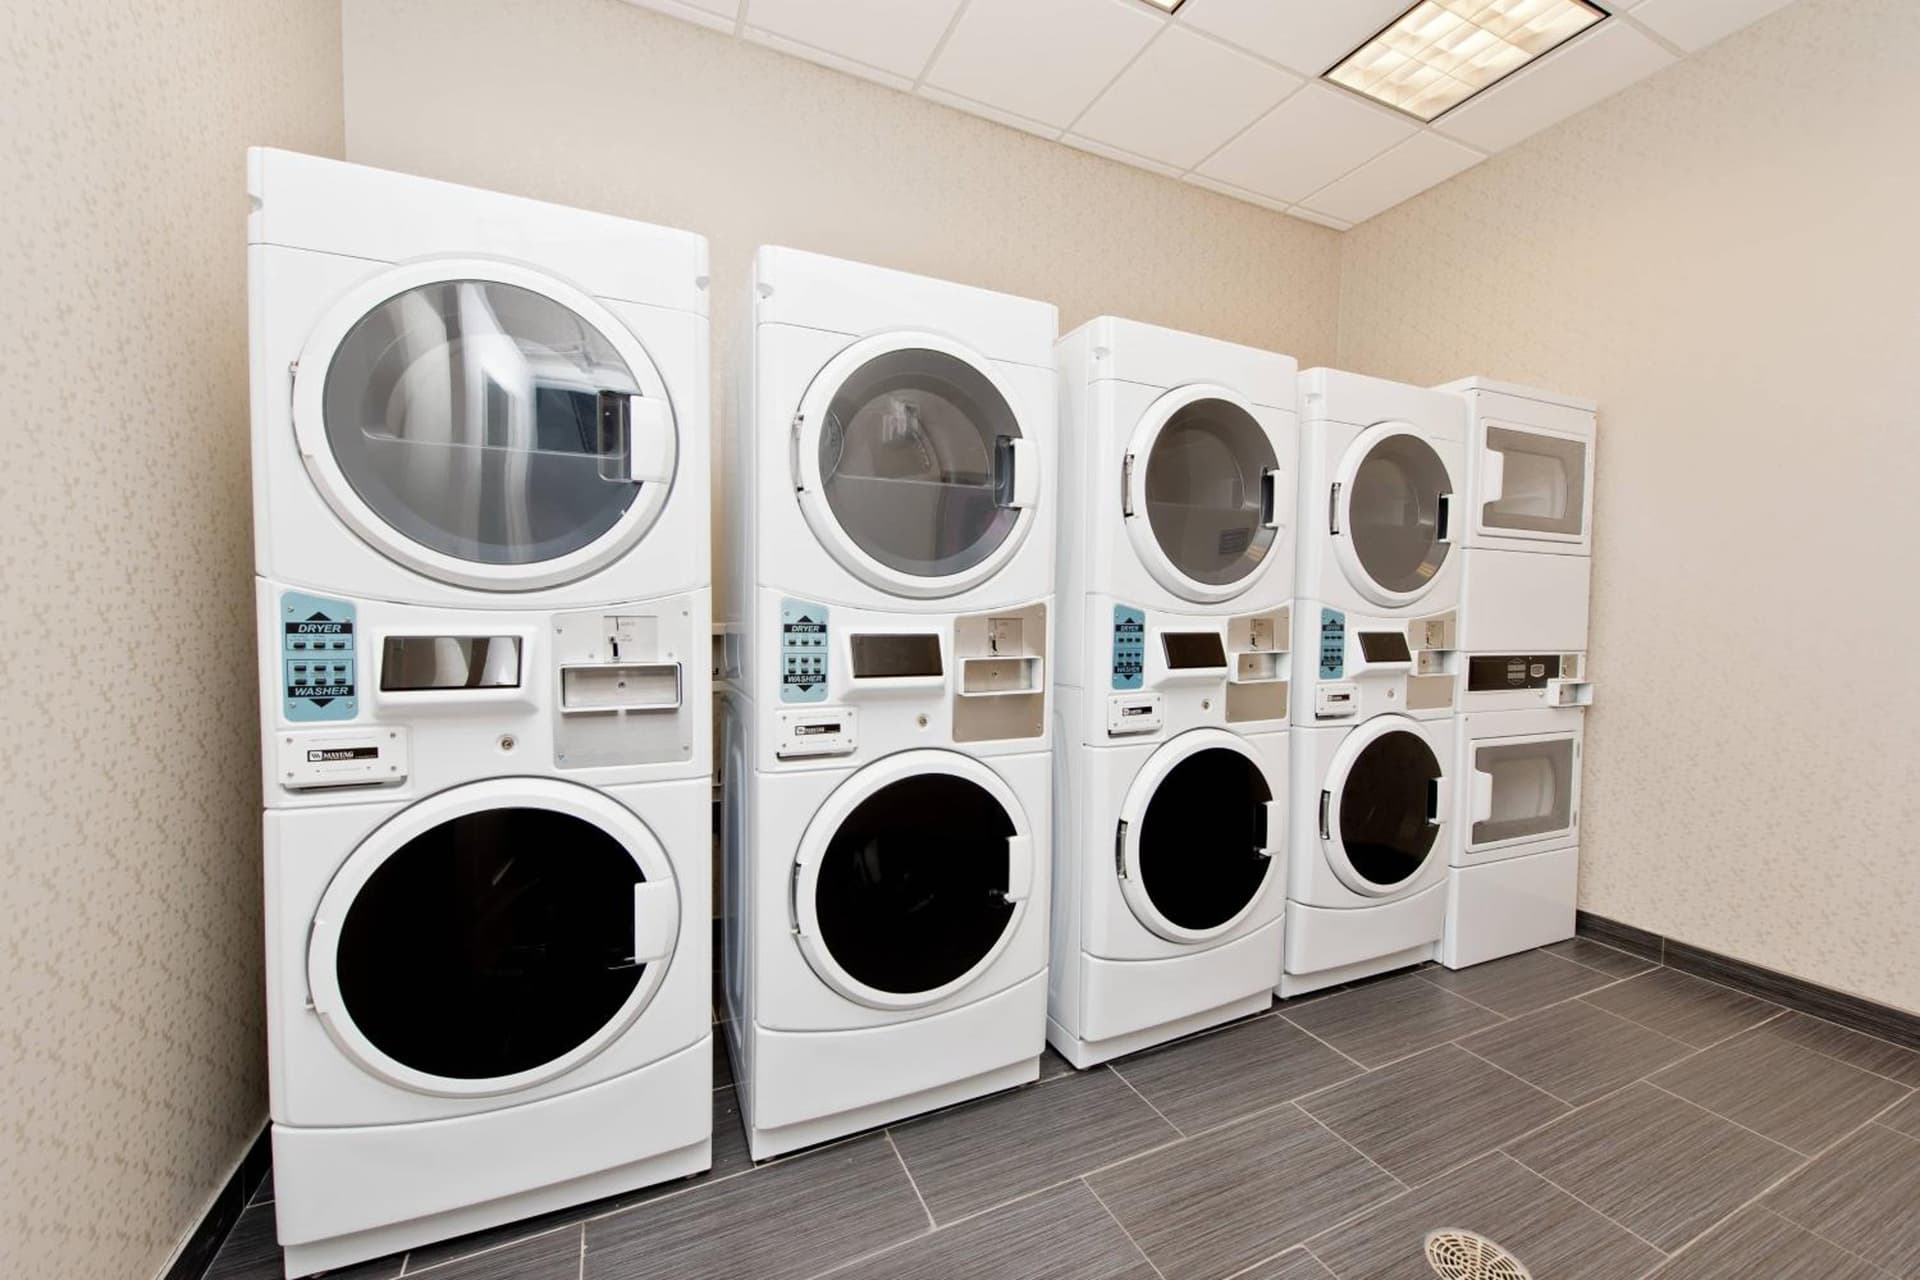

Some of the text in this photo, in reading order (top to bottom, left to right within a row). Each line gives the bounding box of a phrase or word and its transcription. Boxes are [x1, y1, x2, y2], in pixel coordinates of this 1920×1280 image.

[298, 624, 341, 633] DRYER
[788, 675, 823, 683] WASHER
[295, 687, 348, 696] WASHER
[322, 751, 354, 760] MAYTAG
